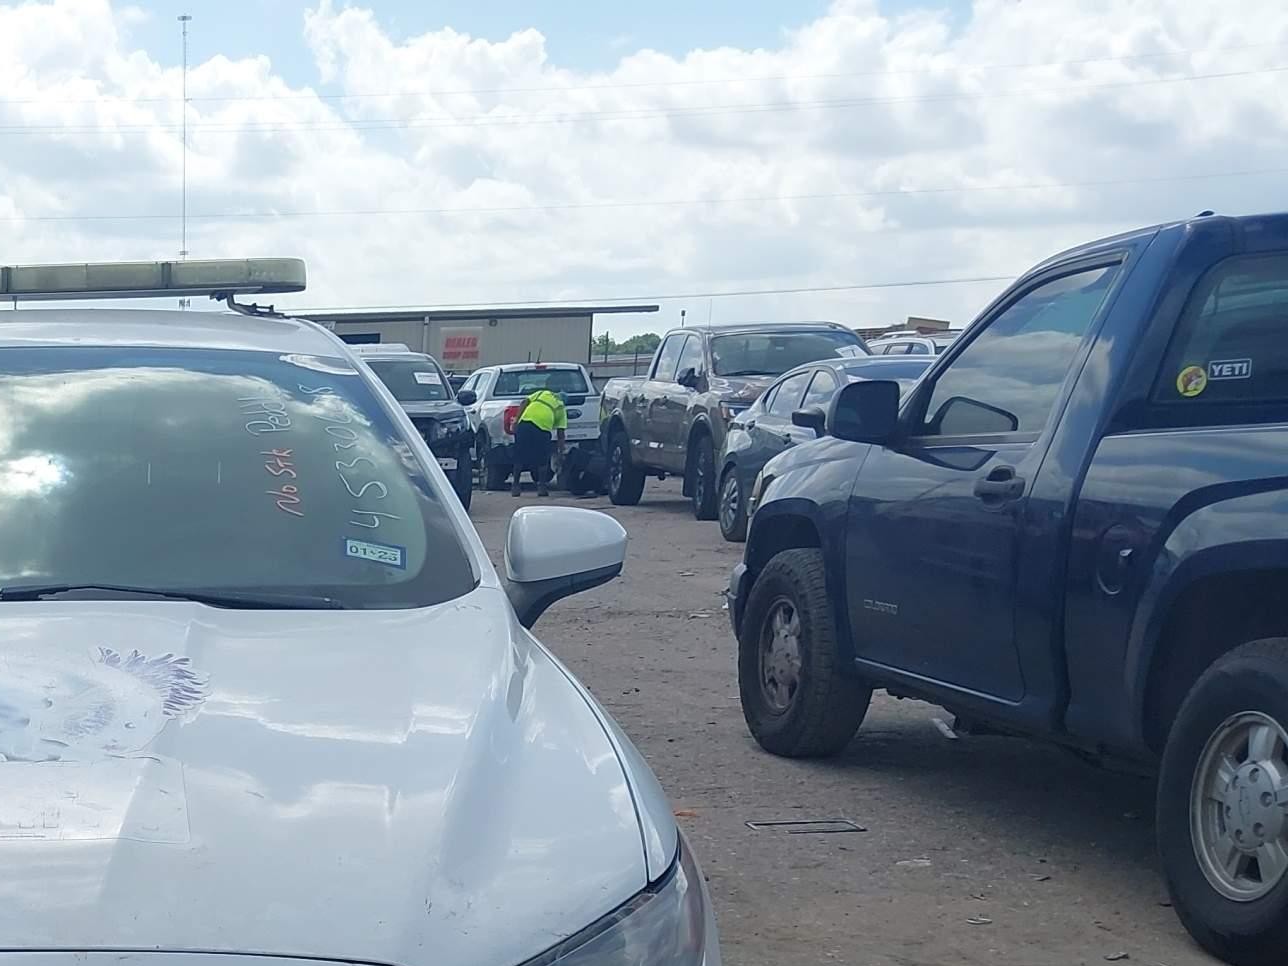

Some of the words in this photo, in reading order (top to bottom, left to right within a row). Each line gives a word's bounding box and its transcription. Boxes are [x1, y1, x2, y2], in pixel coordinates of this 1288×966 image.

[1211, 363, 1248, 376] YETI
[298, 383, 401, 529] 4533068
[265, 484, 305, 517] No
[349, 544, 368, 556] 01
